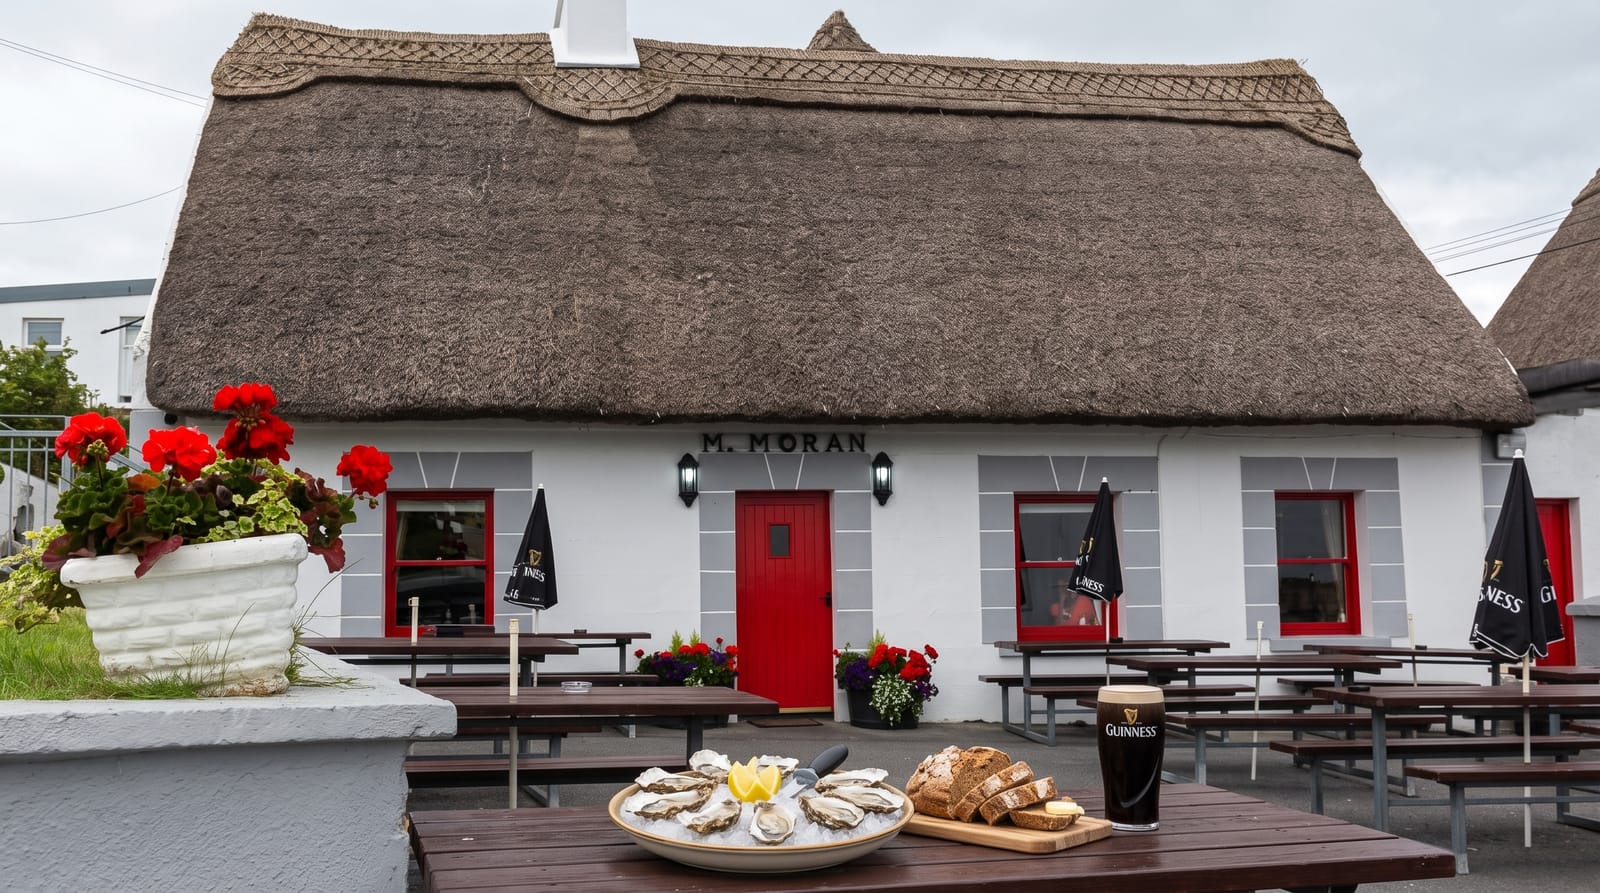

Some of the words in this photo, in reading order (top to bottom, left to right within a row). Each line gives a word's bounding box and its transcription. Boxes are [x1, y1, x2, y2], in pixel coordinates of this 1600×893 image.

[702, 433, 734, 453] M.
[749, 433, 867, 453] MORAN
[1105, 723, 1158, 738] GUINNESS
